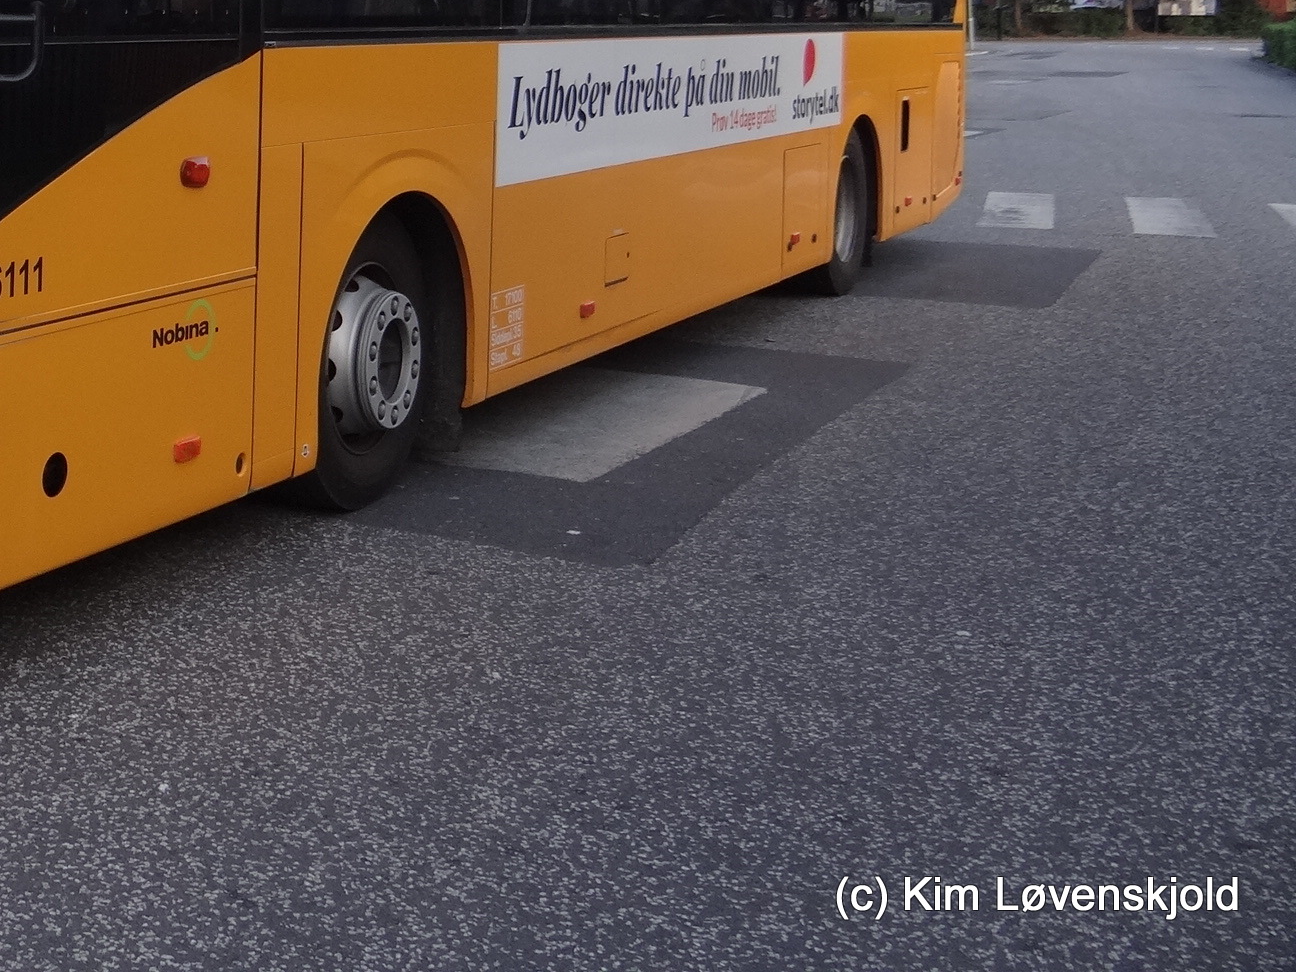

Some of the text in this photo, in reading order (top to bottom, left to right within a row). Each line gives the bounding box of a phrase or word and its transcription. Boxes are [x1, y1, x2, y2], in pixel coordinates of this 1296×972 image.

[614, 62, 681, 116] direkte
[683, 59, 706, 118] på
[709, 58, 735, 105] din
[738, 55, 781, 101] mobil.
[792, 86, 840, 125] storytel.dk
[152, 320, 209, 349] Nobina
